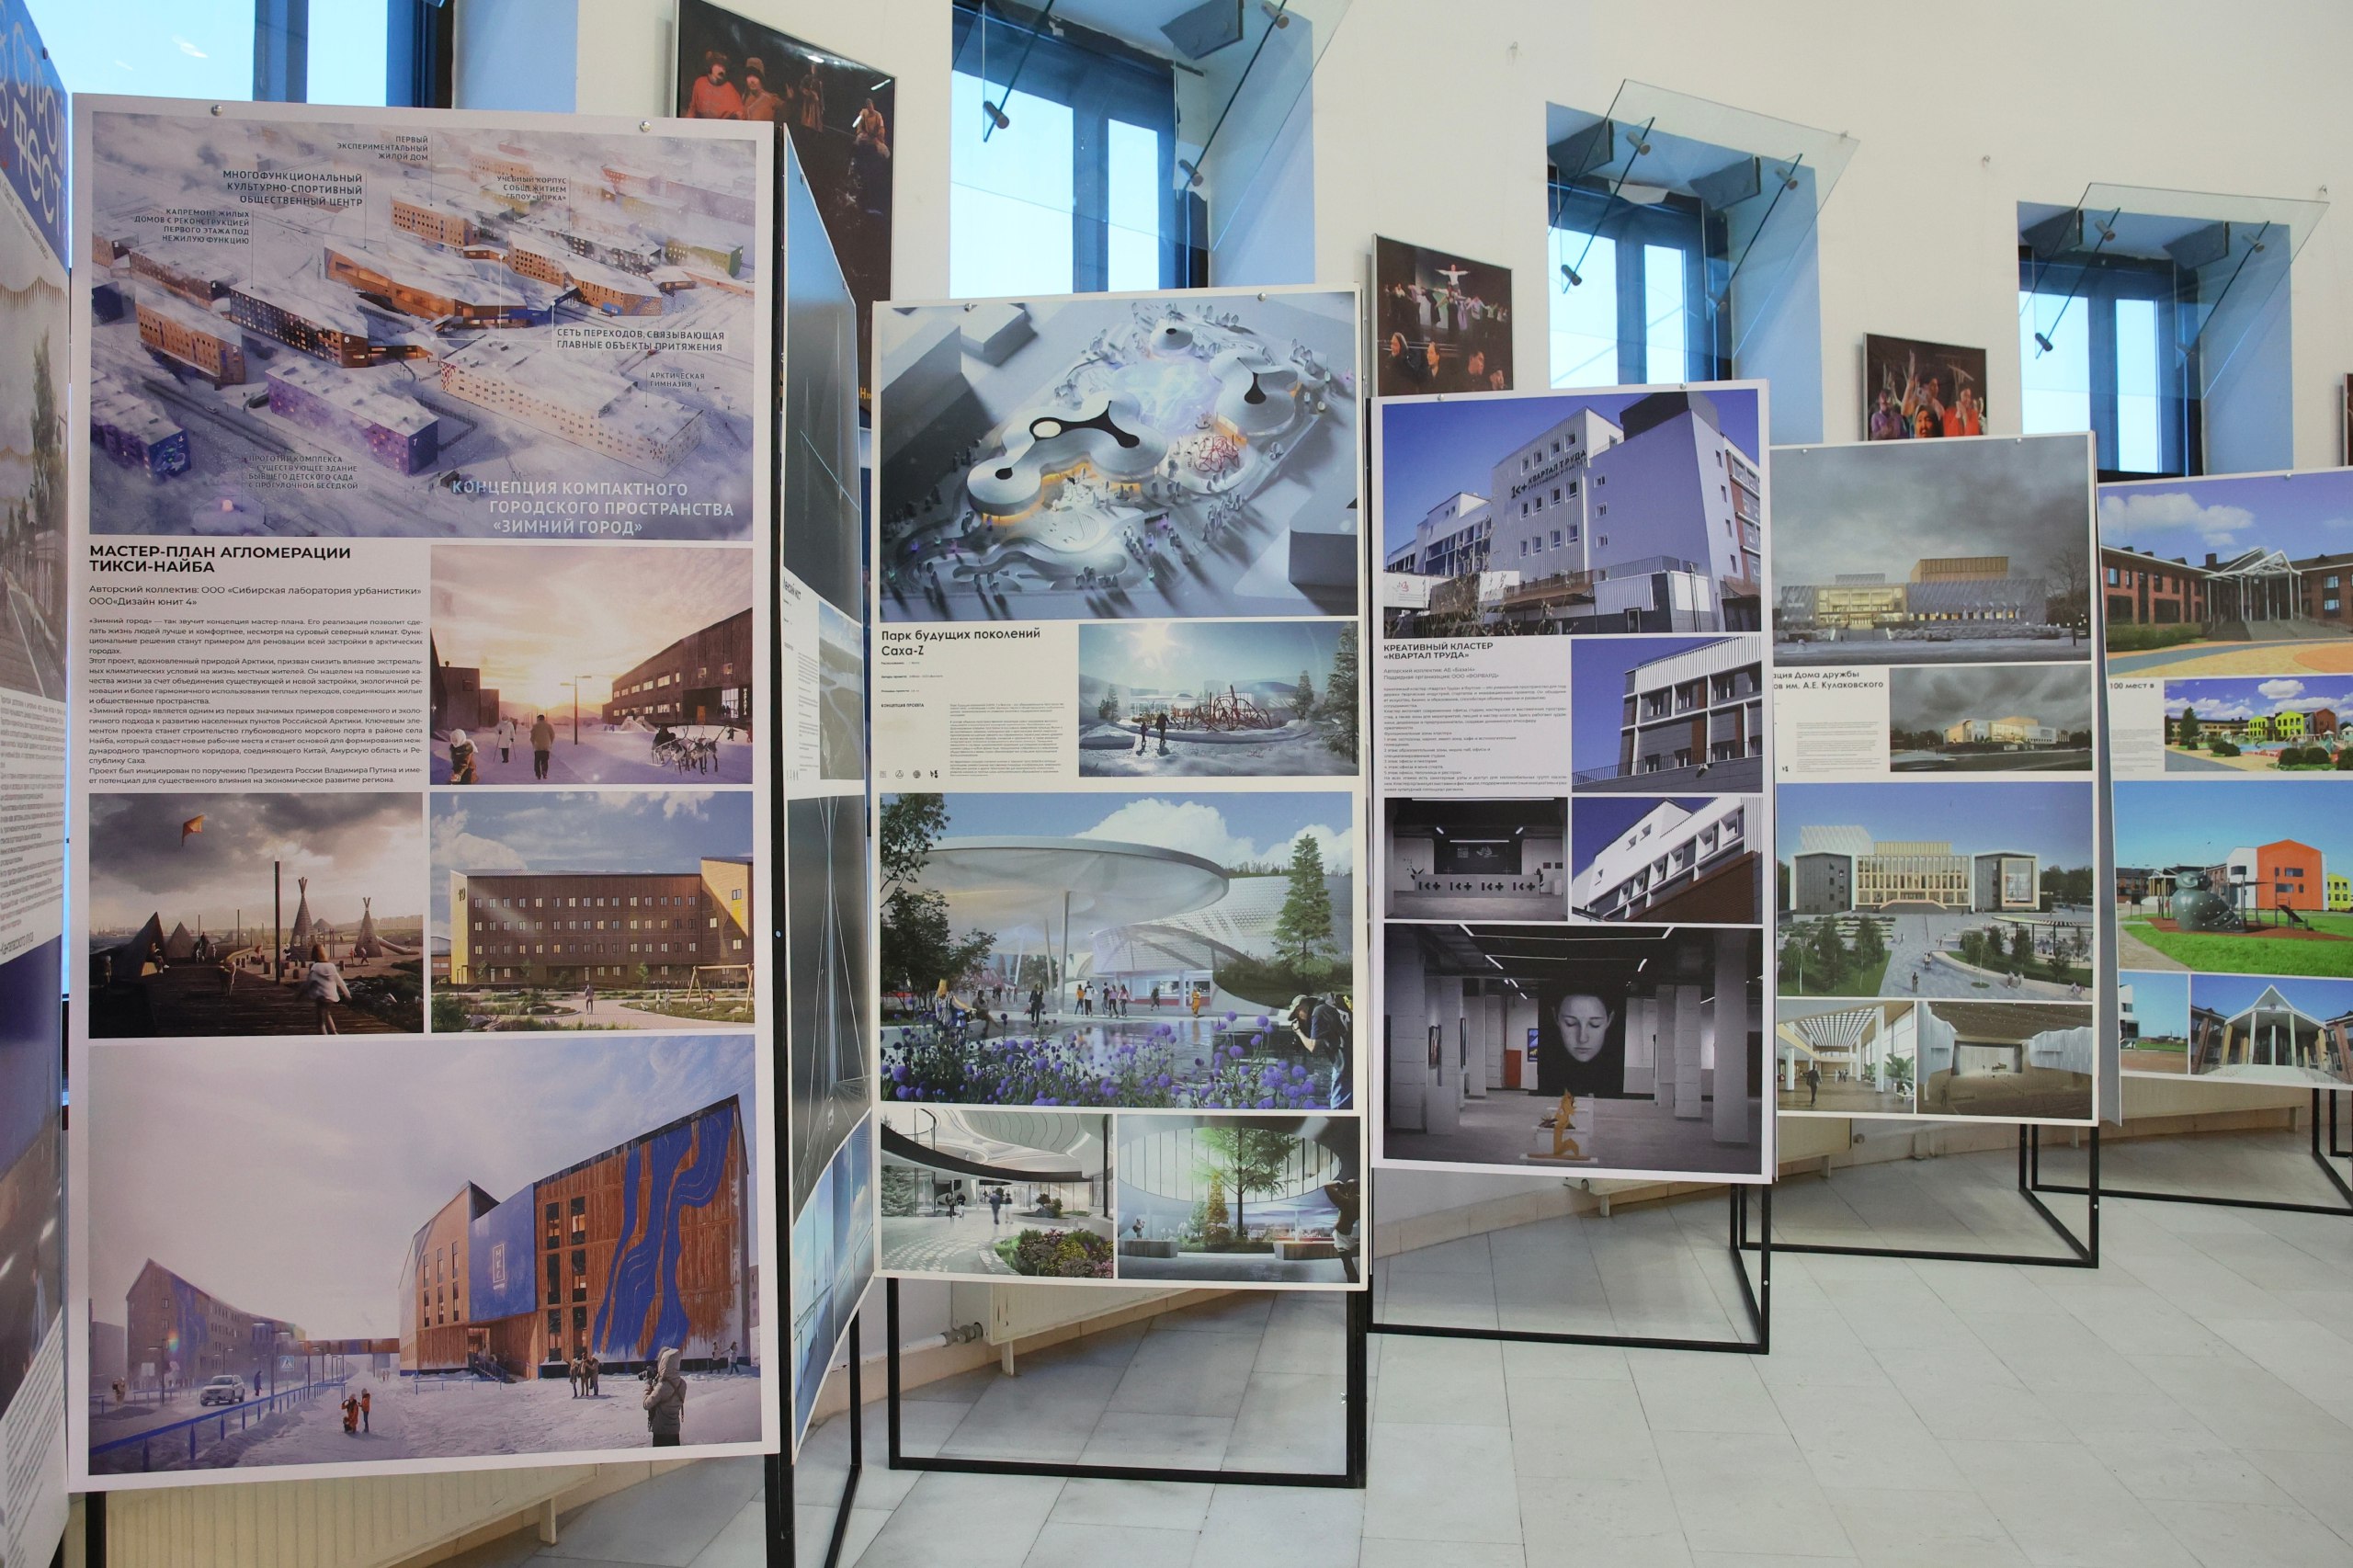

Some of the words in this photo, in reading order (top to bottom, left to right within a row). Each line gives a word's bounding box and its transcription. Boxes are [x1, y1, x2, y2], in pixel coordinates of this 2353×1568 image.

[395, 135, 428, 143] ПЕРВЫЙ
[337, 142, 428, 153] ЭКСПЕРИМЕНТАЛЬНЫЙ
[378, 151, 408, 160] ЖИЛОЙ
[410, 153, 428, 161] ДОМ
[222, 170, 362, 183] МНОГОФУНКЦИОНАЛЬНЫЙ
[227, 182, 362, 195] КУЛЬТУРНО-СПОРТИВНЫЙ
[509, 184, 566, 193] ОБЩЕЖИТИЕМ
[239, 194, 326, 207] ОБЩЕСТВЕННЫЙ
[329, 197, 363, 207] ЦЕНТР
[166, 208, 216, 217] КАПРЕМОНТ
[174, 218, 250, 227] РЕКОНСТРУКЦИЕЙ
[557, 328, 581, 337] СЕТЬ
[647, 330, 725, 342] СВЯЗЫВАЮЩАЯ
[557, 340, 603, 350] ГЛАВНЫЕ
[605, 340, 652, 351] ОБЪЕКТЫ
[654, 342, 723, 352] ПРИТЯЖЕНИЯ
[452, 480, 557, 496] КОНЦЕПЦИЯ
[562, 482, 688, 497] КОМПАКТНОГО
[490, 500, 599, 516] ГОРОДСКОГО
[605, 502, 734, 517] ПРОСТРАНСТВА
[494, 518, 575, 534] «ЗИМНИЙ
[579, 520, 642, 537] ГОРОД»
[89, 545, 216, 558] МАСТЕР-ПЛАН
[221, 547, 351, 561] АГЛОМЕРАЦИИ
[89, 558, 215, 573] ТИКСИ-НАЙБА
[89, 585, 143, 595] Авторский
[201, 586, 226, 595] ООО
[227, 586, 286, 596] «Сибирская
[288, 586, 352, 597] лаборатория
[353, 586, 422, 597] урбанистики»
[88, 597, 156, 607] ООО«Дизайн
[185, 597, 197, 606] 4»
[134, 627, 161, 636] людей
[162, 628, 187, 636] лучше
[196, 628, 245, 636] комфортнее,
[296, 628, 329, 637] суровый
[330, 628, 369, 637] северный
[882, 631, 912, 642] Парк
[915, 630, 970, 642] будущих
[974, 628, 1041, 639] поколений
[881, 645, 924, 656] Саха-Z
[1384, 642, 1448, 652] КРЕАТИВНЫЙ
[89, 657, 106, 665] Этот
[137, 657, 199, 666] вдохновленный
[241, 658, 276, 666] Арктики,
[1823, 671, 1859, 679] дружбы
[1822, 682, 1884, 690] Кулаковского
[303, 747, 328, 755] Китай,
[330, 747, 369, 756] Амурскую
